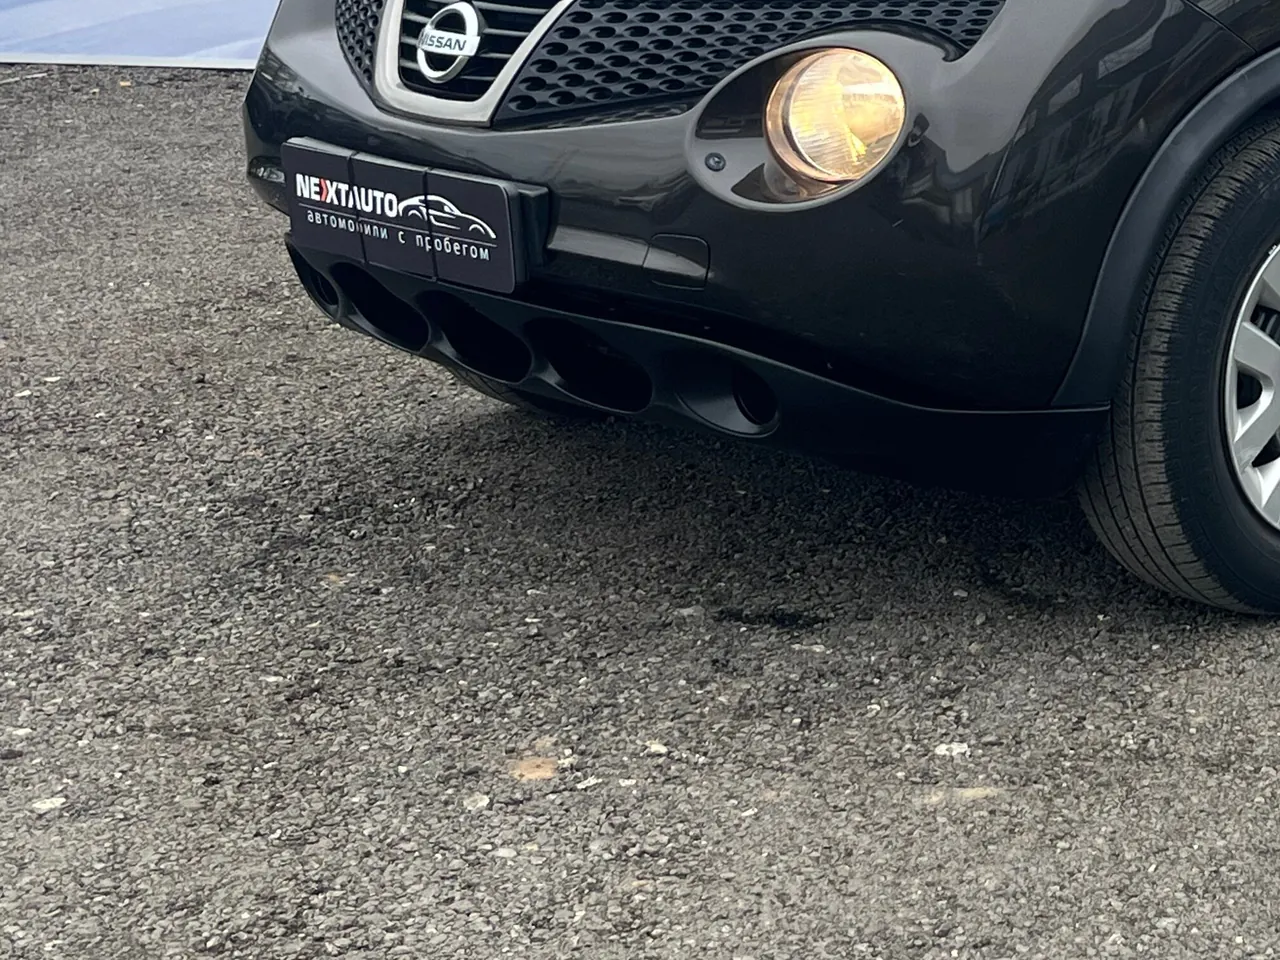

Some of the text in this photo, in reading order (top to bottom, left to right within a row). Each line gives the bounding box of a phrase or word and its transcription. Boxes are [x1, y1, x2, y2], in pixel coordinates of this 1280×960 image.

[419, 32, 467, 52] NISSAN
[295, 173, 398, 218] NEXTAUTO
[398, 230, 406, 244] с
[415, 234, 490, 261] пробегом
